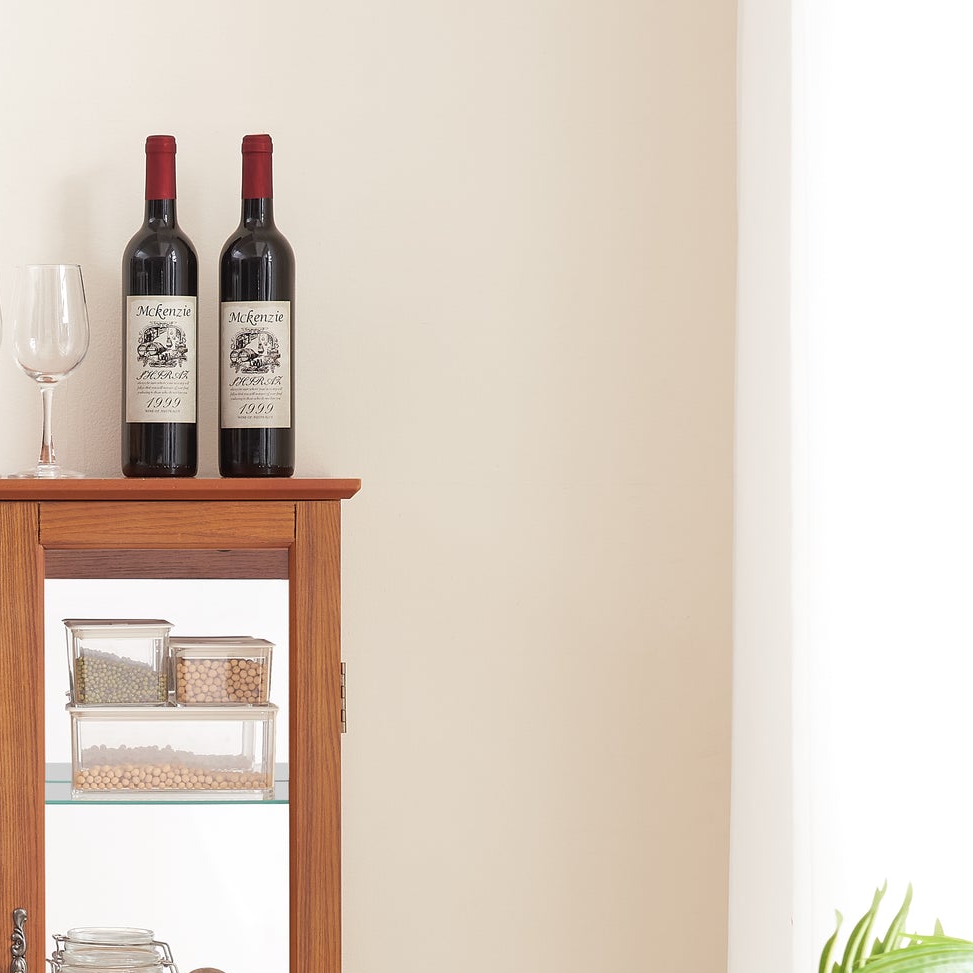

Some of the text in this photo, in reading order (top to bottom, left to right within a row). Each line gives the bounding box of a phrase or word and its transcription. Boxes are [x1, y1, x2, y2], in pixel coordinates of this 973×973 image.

[136, 303, 192, 320] Mckenzie
[228, 310, 284, 326] Mckenzie
[146, 396, 181, 408] 1999
[239, 403, 274, 415] 1999
